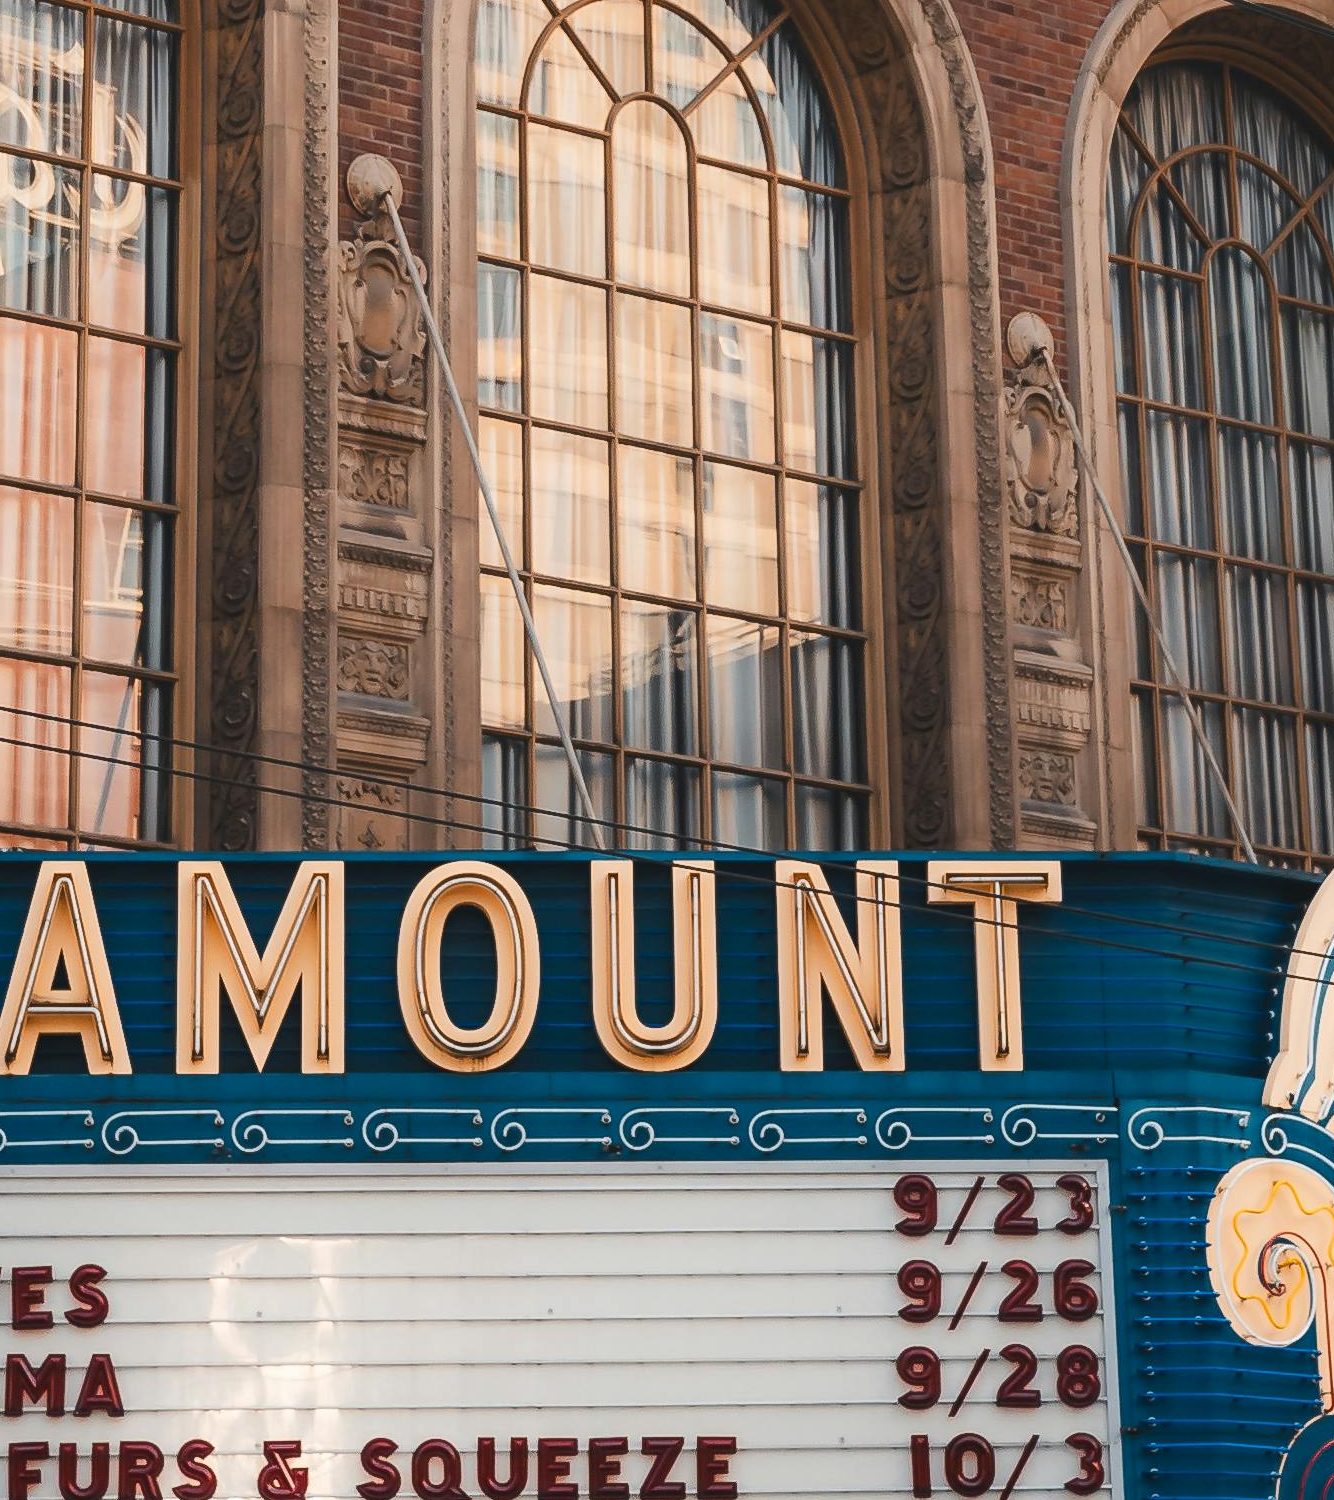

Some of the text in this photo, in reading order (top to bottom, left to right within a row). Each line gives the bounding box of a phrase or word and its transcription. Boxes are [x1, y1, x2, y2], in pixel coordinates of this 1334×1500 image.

[892, 1174, 1097, 1246] 9/23
[897, 1259, 1101, 1330] 9/26
[895, 1344, 1102, 1417] 9/28
